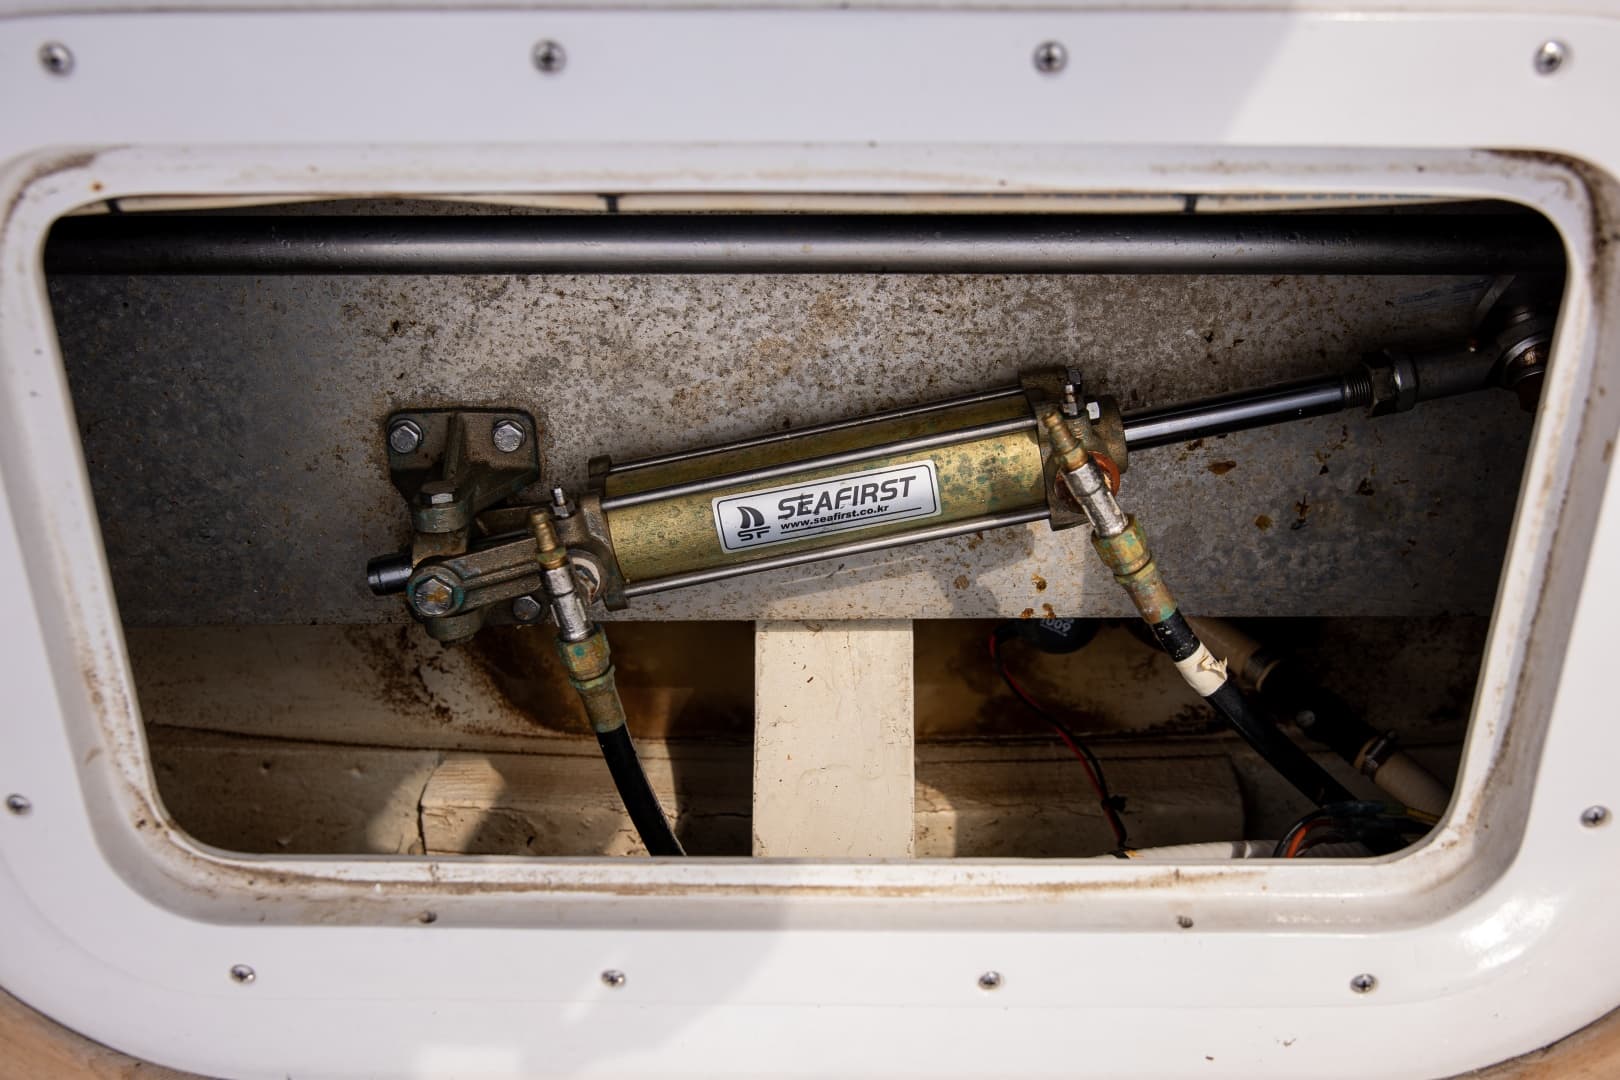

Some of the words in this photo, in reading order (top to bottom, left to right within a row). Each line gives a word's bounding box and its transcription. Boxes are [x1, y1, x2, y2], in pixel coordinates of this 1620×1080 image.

[778, 477, 916, 519] SEAFIRST
[780, 504, 889, 530] www.seafirst.co.kr
[737, 526, 770, 541] SF
